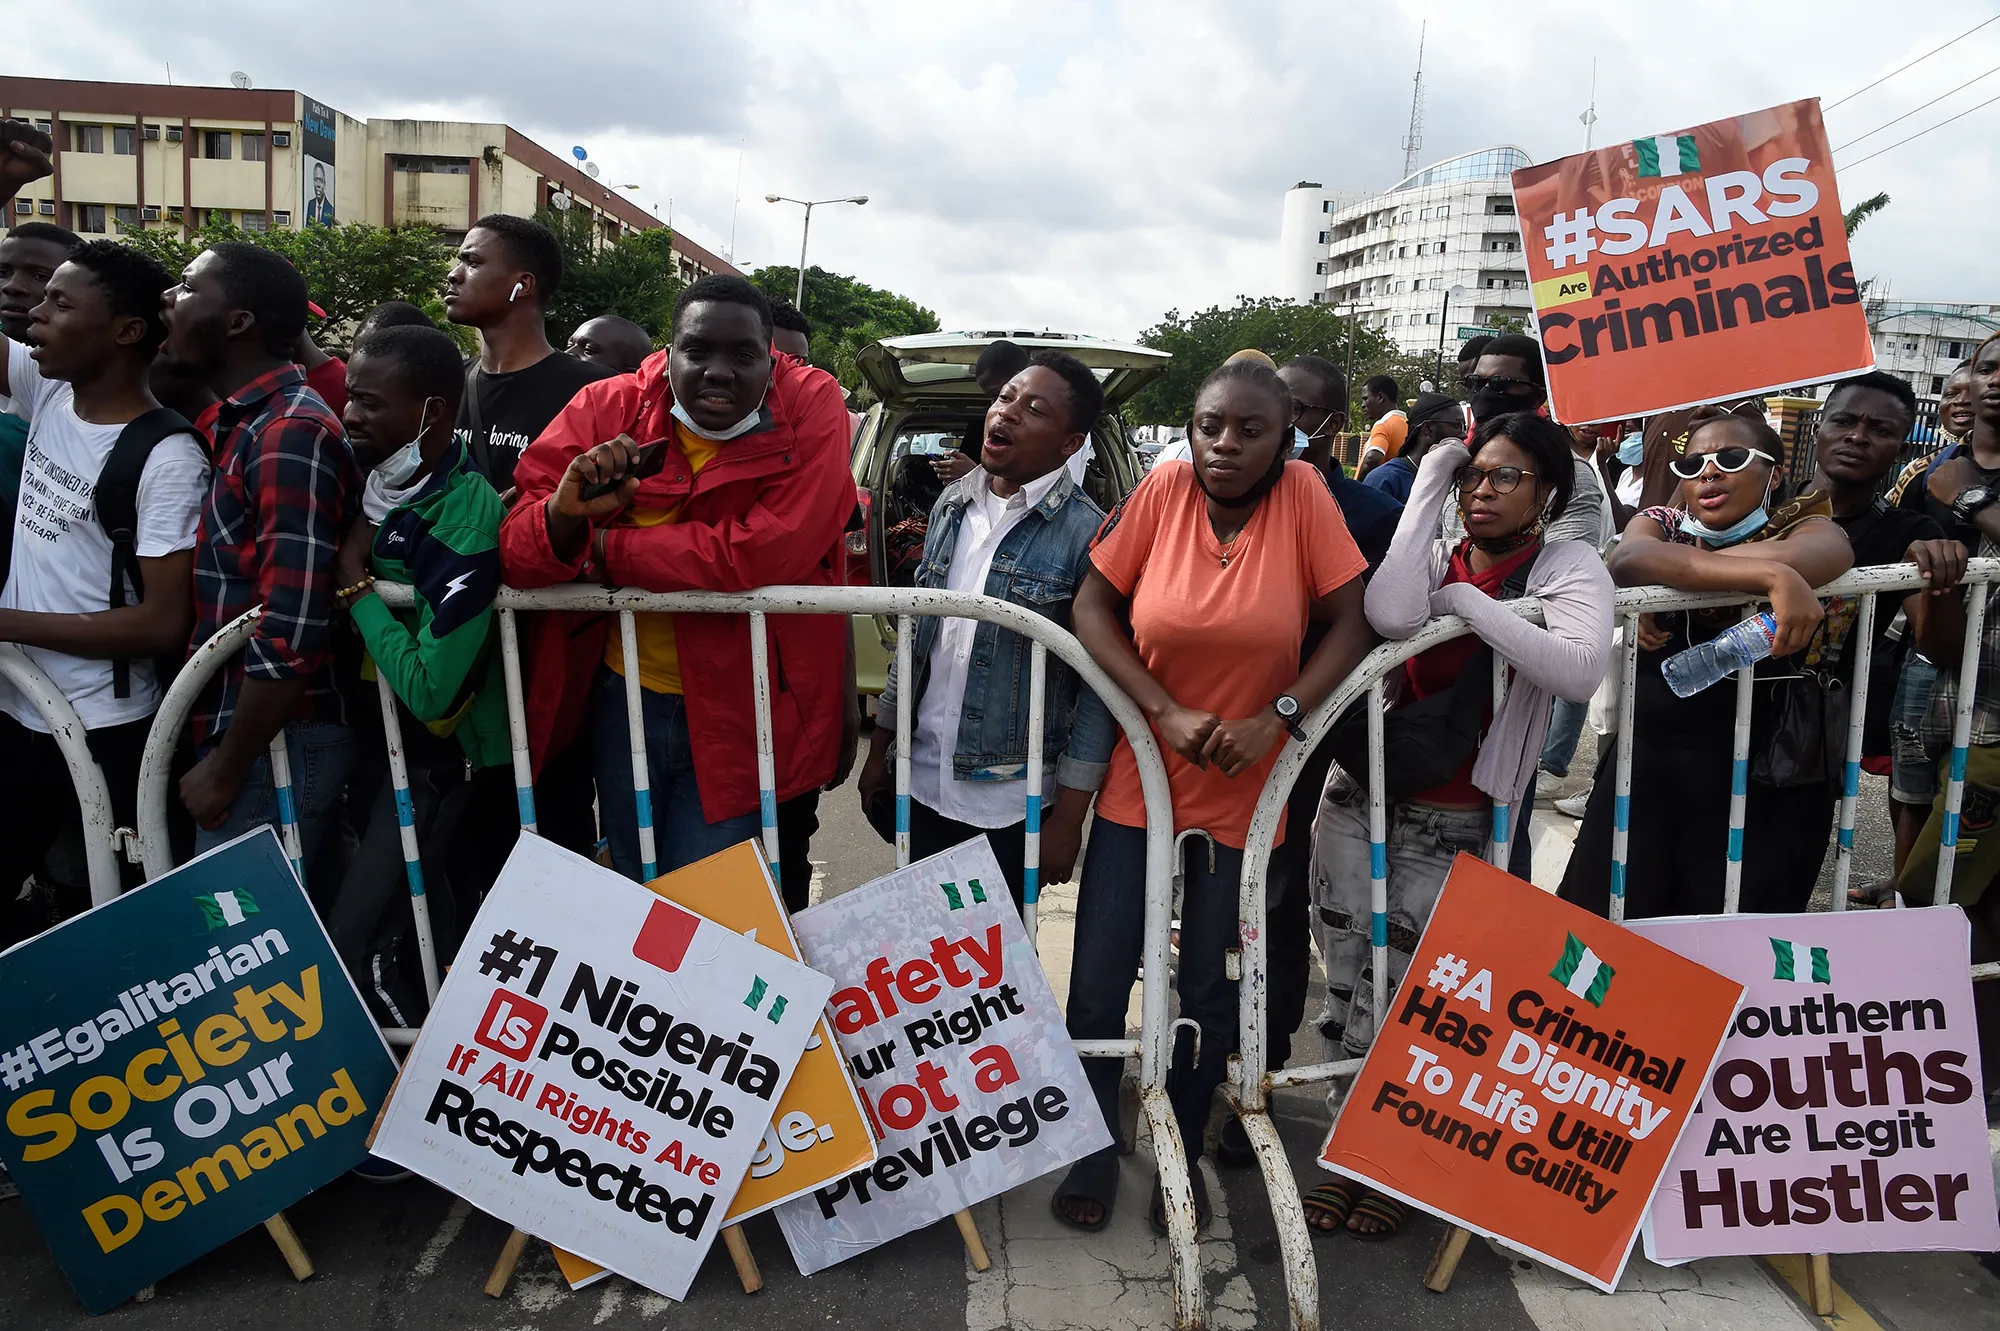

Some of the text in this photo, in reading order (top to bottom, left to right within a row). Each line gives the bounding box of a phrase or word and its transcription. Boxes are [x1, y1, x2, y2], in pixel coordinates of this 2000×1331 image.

[305, 112, 319, 134] New
[1544, 157, 1819, 270] #SARS
[1559, 216, 1824, 297] Are Authorized
[1538, 254, 1860, 365] Criminals
[44, 461, 82, 492] UNSIGNED
[489, 424, 529, 459] boring
[53, 494, 71, 512] GIVE
[67, 502, 90, 521] THEM
[0, 928, 290, 1092] #Egalitarian
[478, 929, 559, 998] #1
[560, 962, 781, 1101] Nigeria
[829, 924, 1004, 1035] afety
[847, 1038, 897, 1080] ur
[903, 984, 1025, 1059] Right
[1427, 952, 1686, 1095] #A Criminal
[1727, 993, 1947, 1039] outhern
[6, 964, 324, 1162] Society
[96, 1052, 294, 1184] Is Our
[445, 1043, 721, 1187] If All Rights Are
[486, 1003, 734, 1139] Is Possible
[858, 1044, 1020, 1142] ot a
[1398, 986, 1672, 1141] Has Dignity
[1404, 1044, 1633, 1175] To Life Utill
[1694, 1036, 1973, 1114] ouths
[81, 1067, 368, 1255] Demand
[424, 1080, 716, 1242] Respected
[811, 1086, 1069, 1221] Previlege
[1371, 1081, 1619, 1214] Found Guilty
[1704, 1110, 1936, 1158] Are Legit
[1680, 1159, 1970, 1230] Hustler
